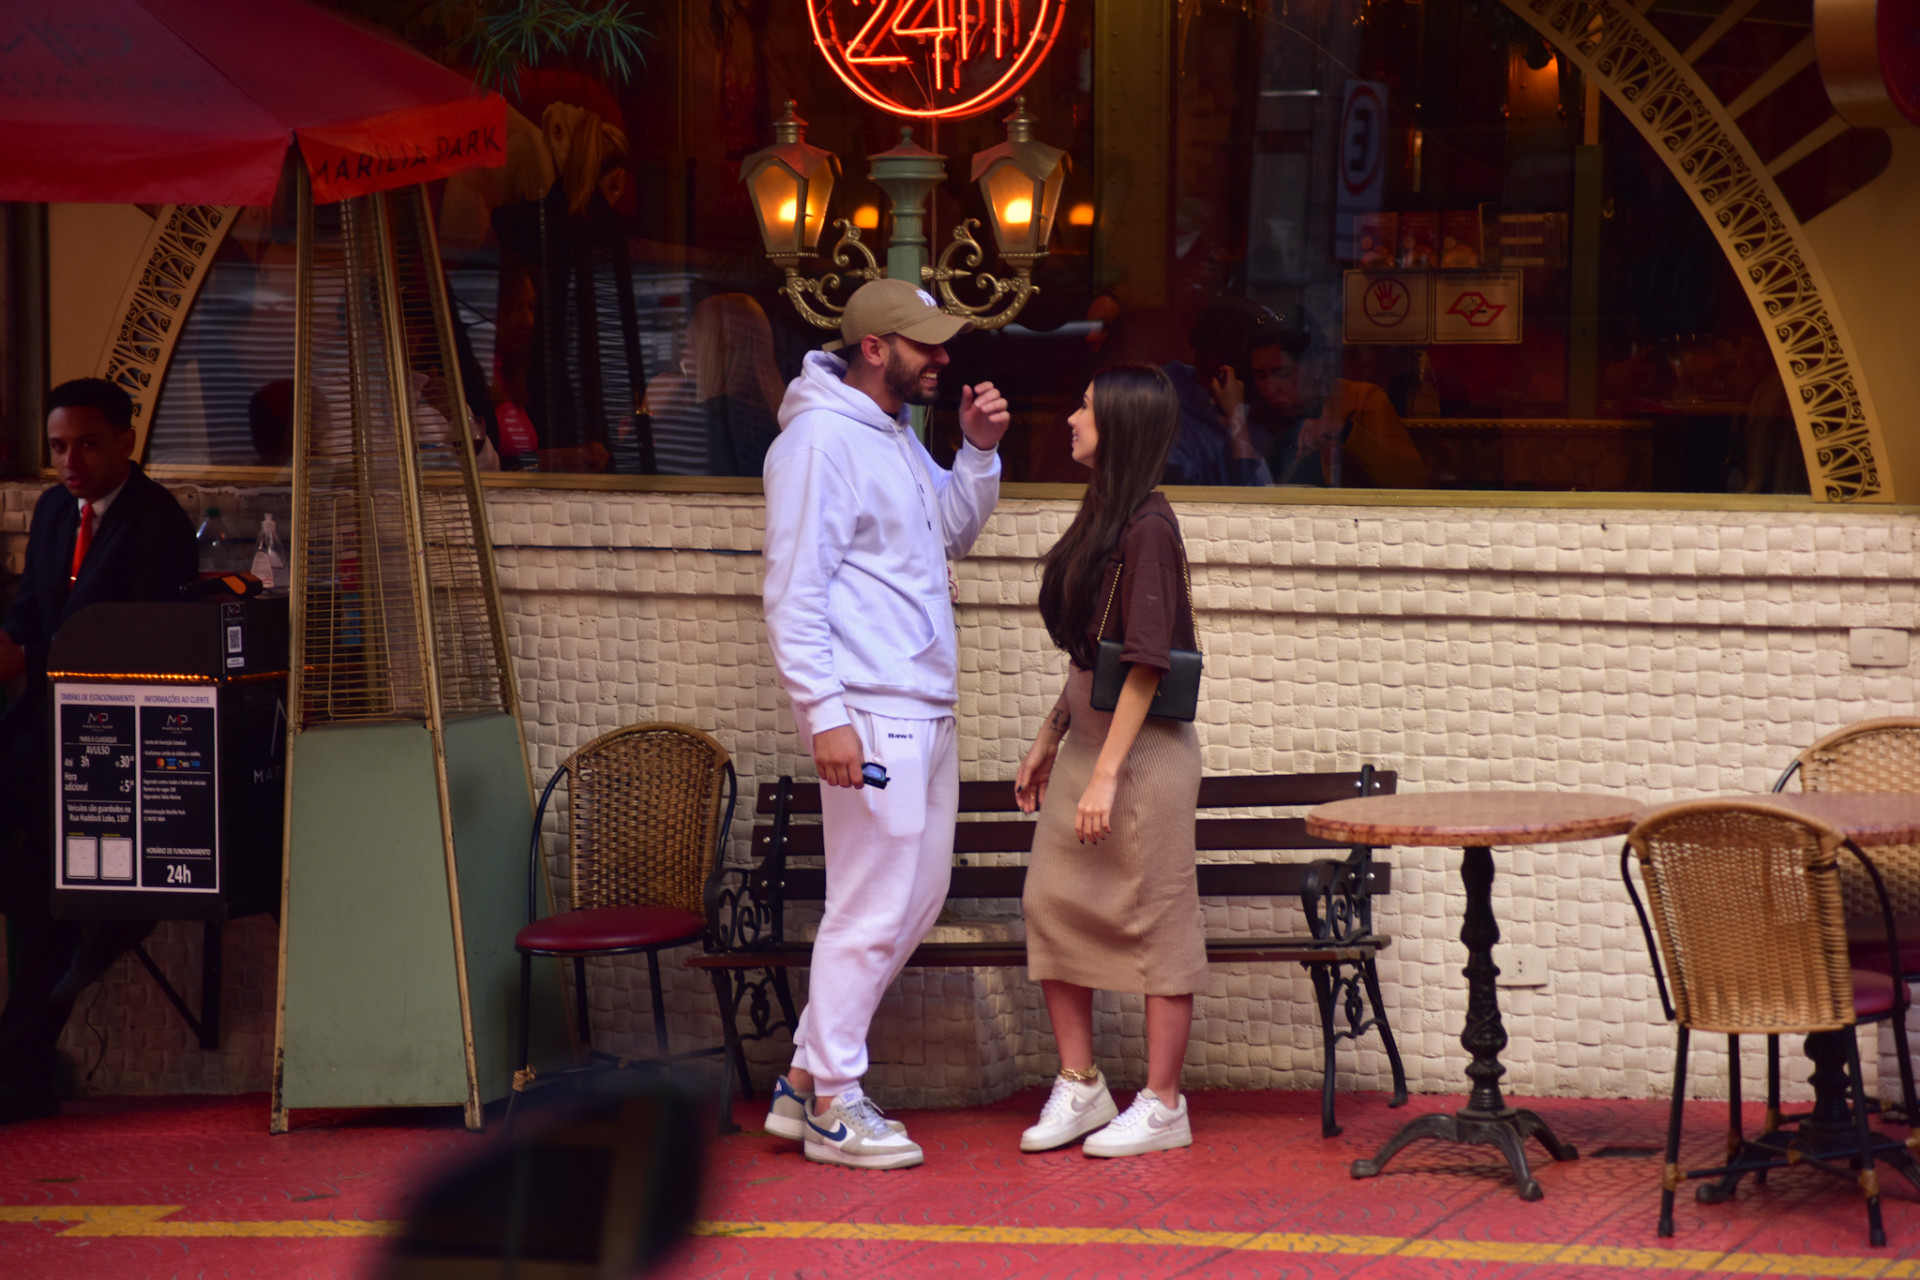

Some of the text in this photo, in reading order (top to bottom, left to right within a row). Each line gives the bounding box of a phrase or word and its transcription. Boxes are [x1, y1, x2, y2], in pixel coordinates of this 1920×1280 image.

[435, 125, 501, 163] PARK
[61, 692, 135, 702] TARIFAS DE ESTACIONAMENTO
[144, 694, 181, 704] INFORMAÇÕES
[190, 696, 210, 704] CLIENTE
[85, 745, 110, 755] AVULSO
[80, 755, 90, 768] 3h
[64, 772, 78, 781] Hora
[64, 782, 88, 792] adicional
[167, 847, 173, 855] DE
[173, 848, 212, 856] FUNCIONAMENTO
[166, 863, 192, 884] 24h
